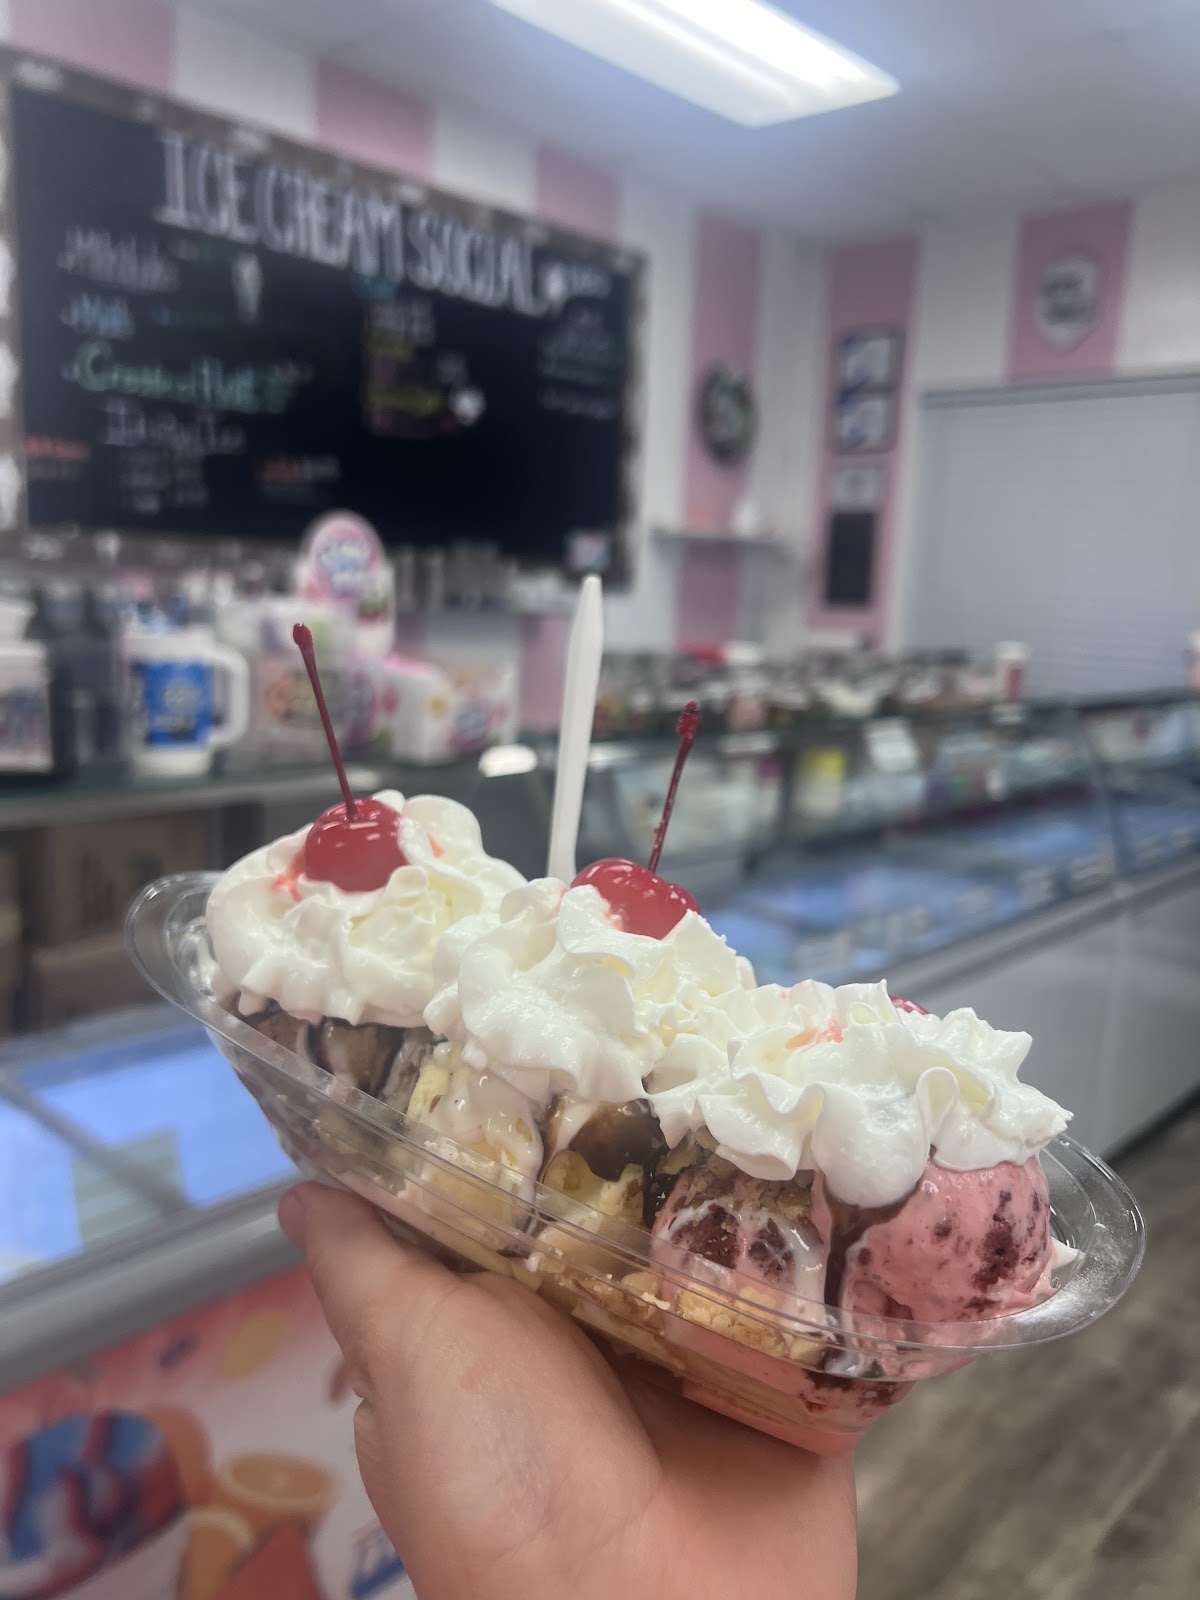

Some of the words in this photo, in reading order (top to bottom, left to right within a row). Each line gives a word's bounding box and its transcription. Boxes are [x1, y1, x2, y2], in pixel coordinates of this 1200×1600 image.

[153, 129, 258, 246] ICE
[254, 162, 405, 284] CREAM
[406, 212, 553, 320] SOCIAL
